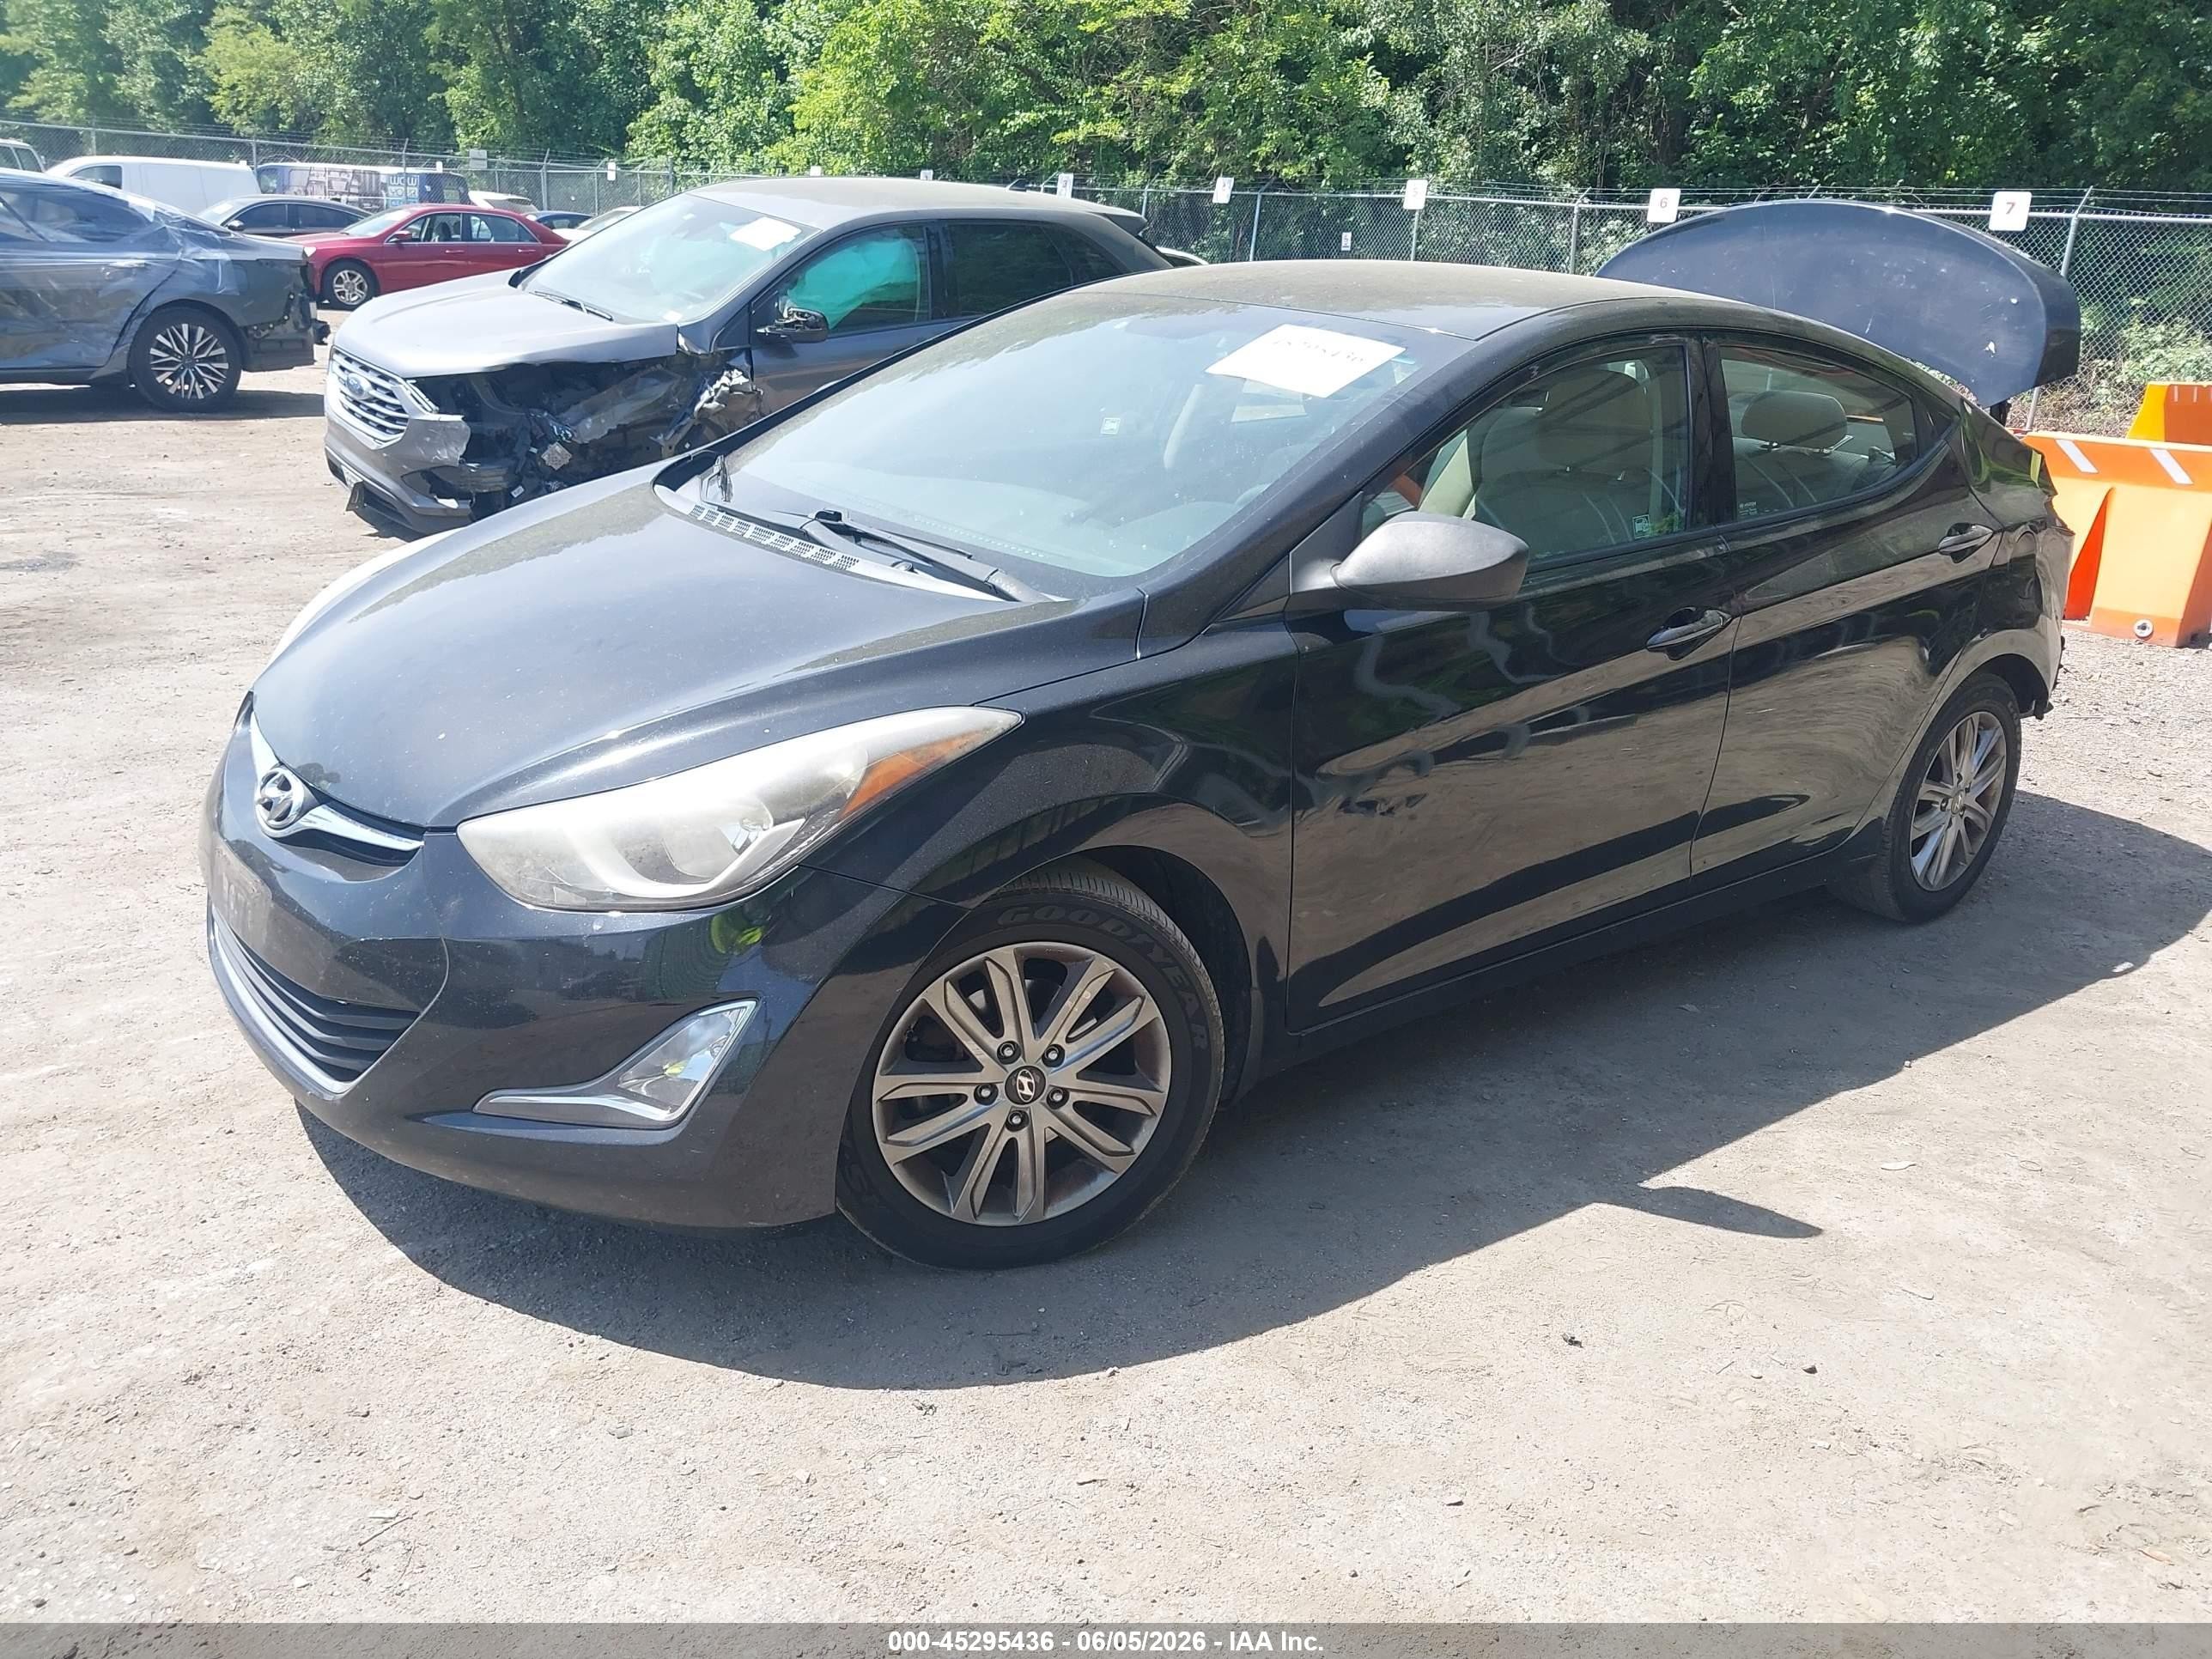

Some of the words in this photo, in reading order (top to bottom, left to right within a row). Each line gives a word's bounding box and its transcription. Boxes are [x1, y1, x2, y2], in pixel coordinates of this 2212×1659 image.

[1660, 197, 1668, 209] 6
[2005, 201, 2016, 215] 7
[996, 904, 1209, 1052] GOODYEAR
